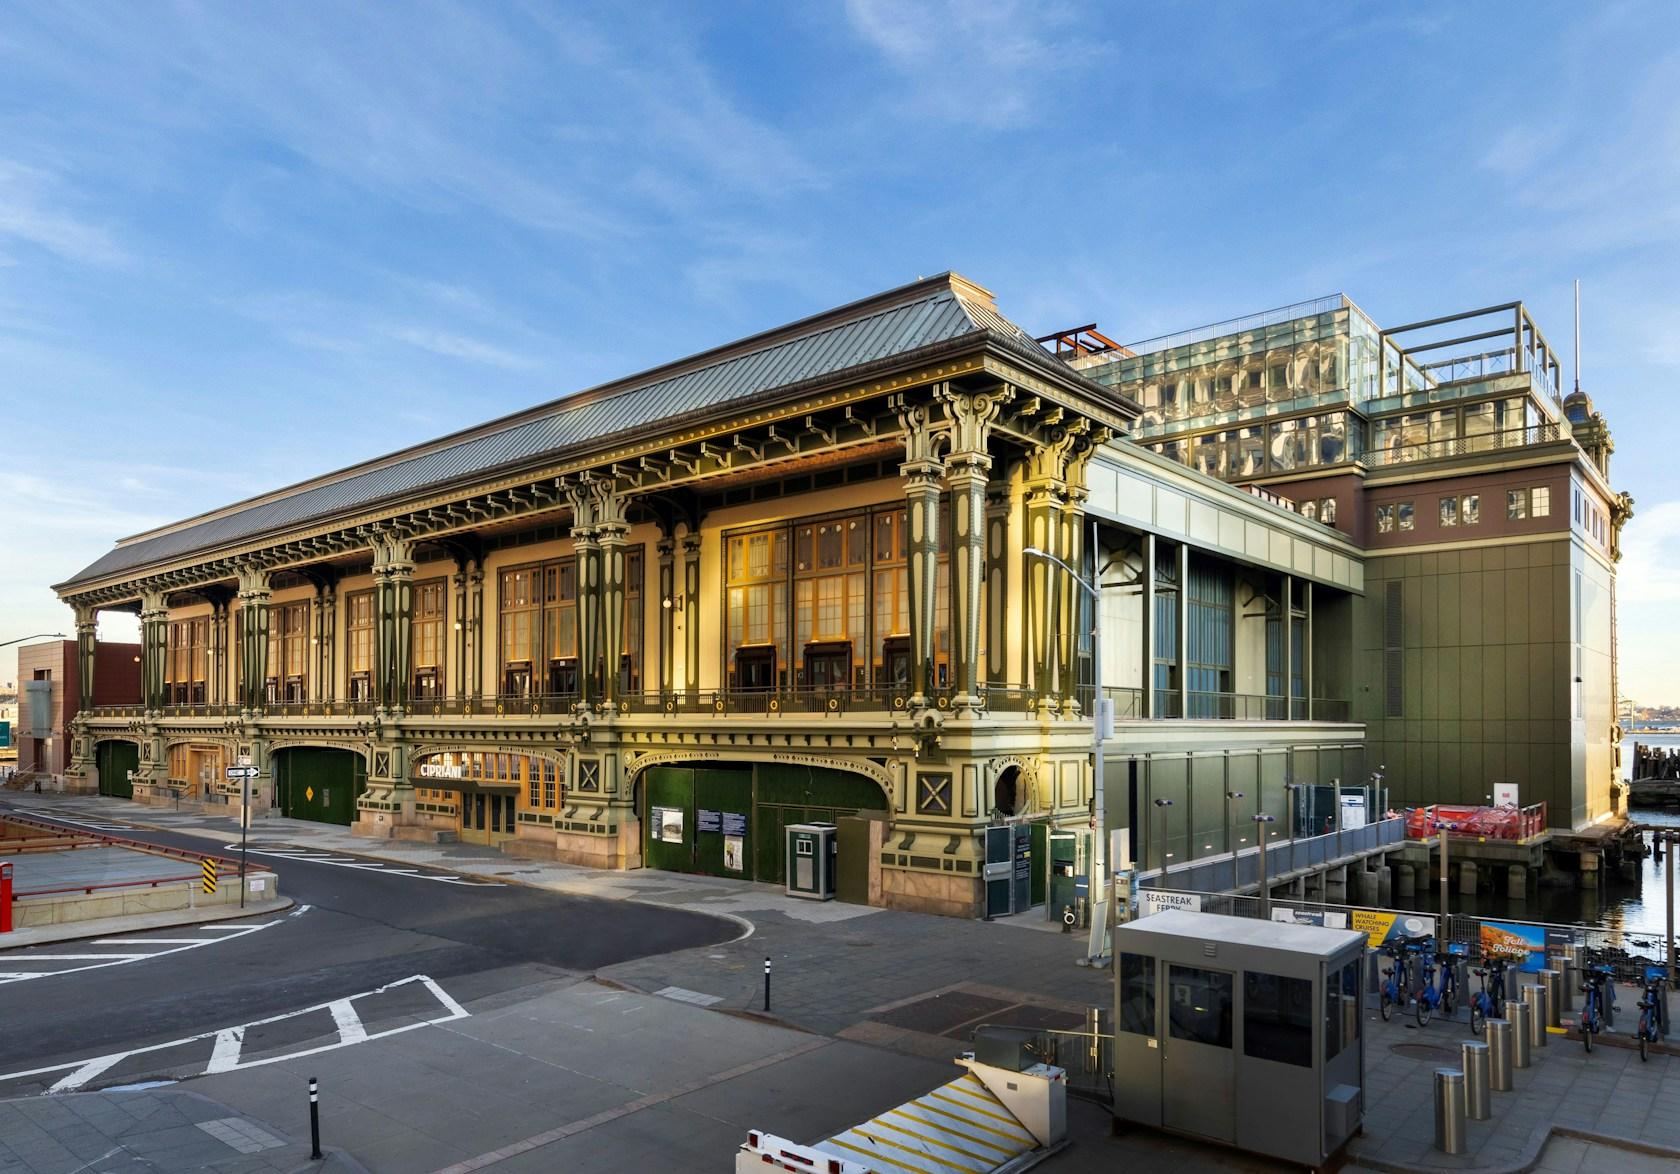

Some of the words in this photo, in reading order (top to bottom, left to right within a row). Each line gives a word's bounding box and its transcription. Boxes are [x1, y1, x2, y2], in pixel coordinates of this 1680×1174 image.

[420, 764, 462, 778] CIPRIANI
[1146, 893, 1192, 905] SEASTREAK
[1355, 919, 1389, 927] WATCHING
